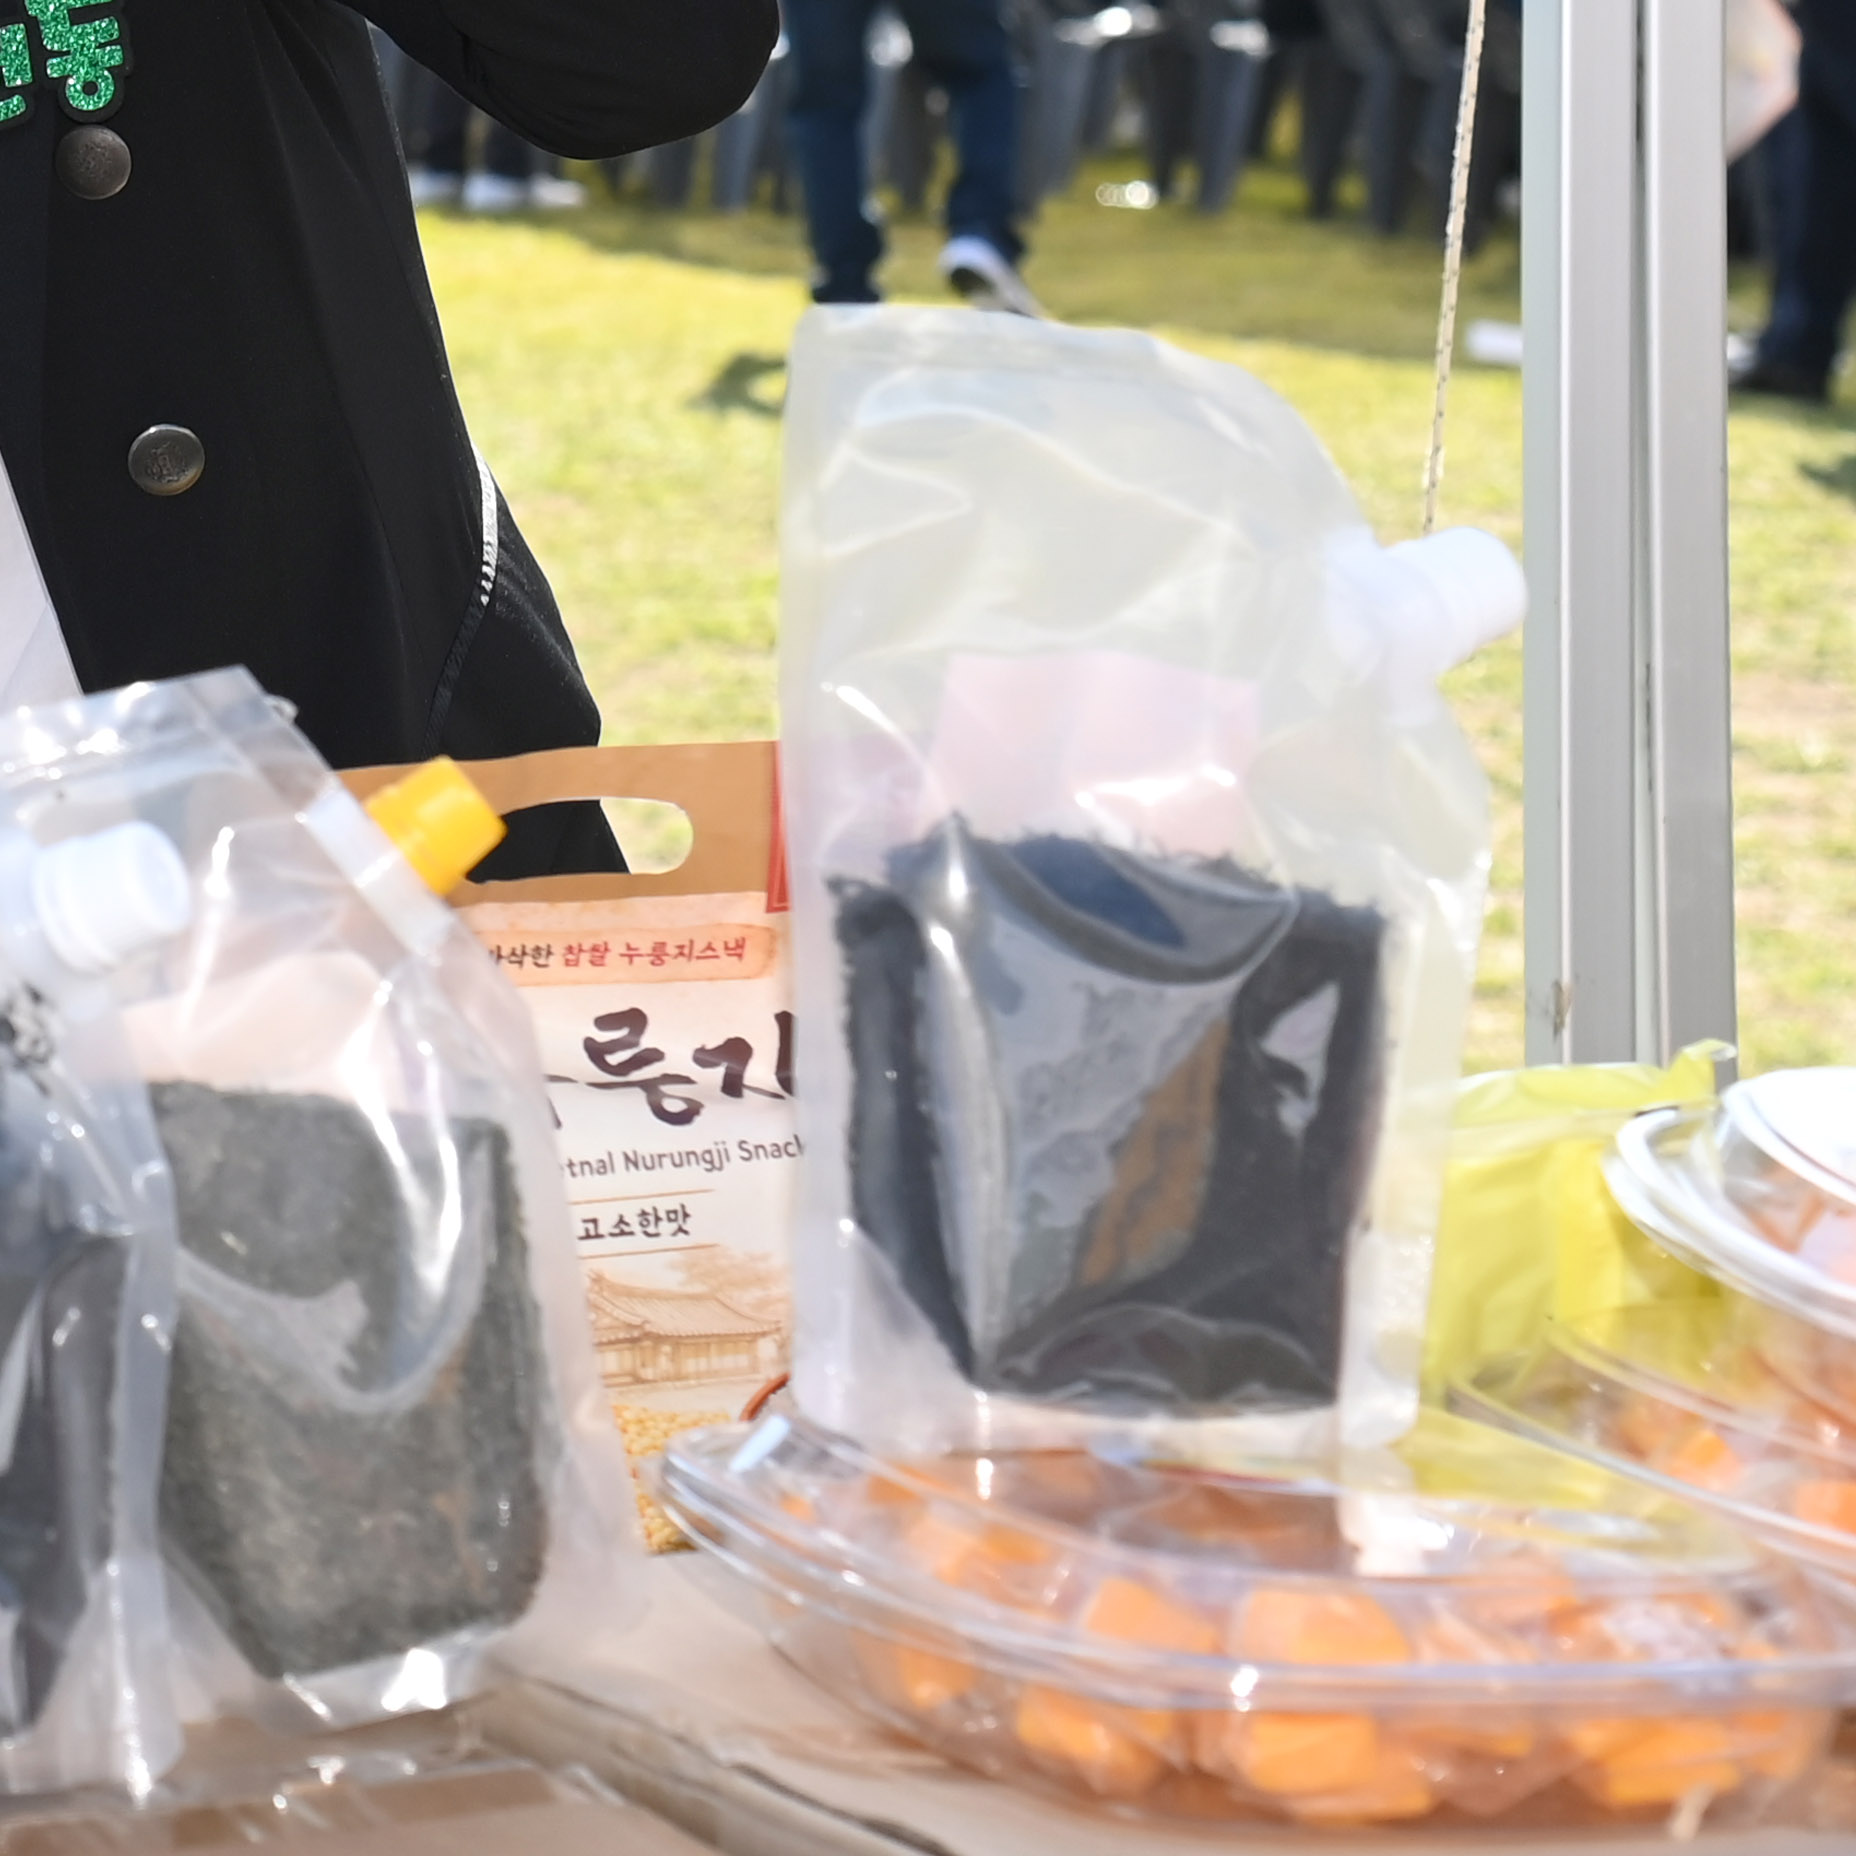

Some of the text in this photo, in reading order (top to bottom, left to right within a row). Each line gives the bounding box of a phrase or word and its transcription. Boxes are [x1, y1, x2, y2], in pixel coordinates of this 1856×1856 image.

[562, 942, 610, 968] 찹쌀
[618, 936, 748, 967] 누룽지스낵
[544, 1006, 798, 1130] 룽지
[561, 1152, 617, 1179] tnal
[623, 1141, 731, 1174] Nurungji
[577, 1204, 693, 1241] 고소한맛
